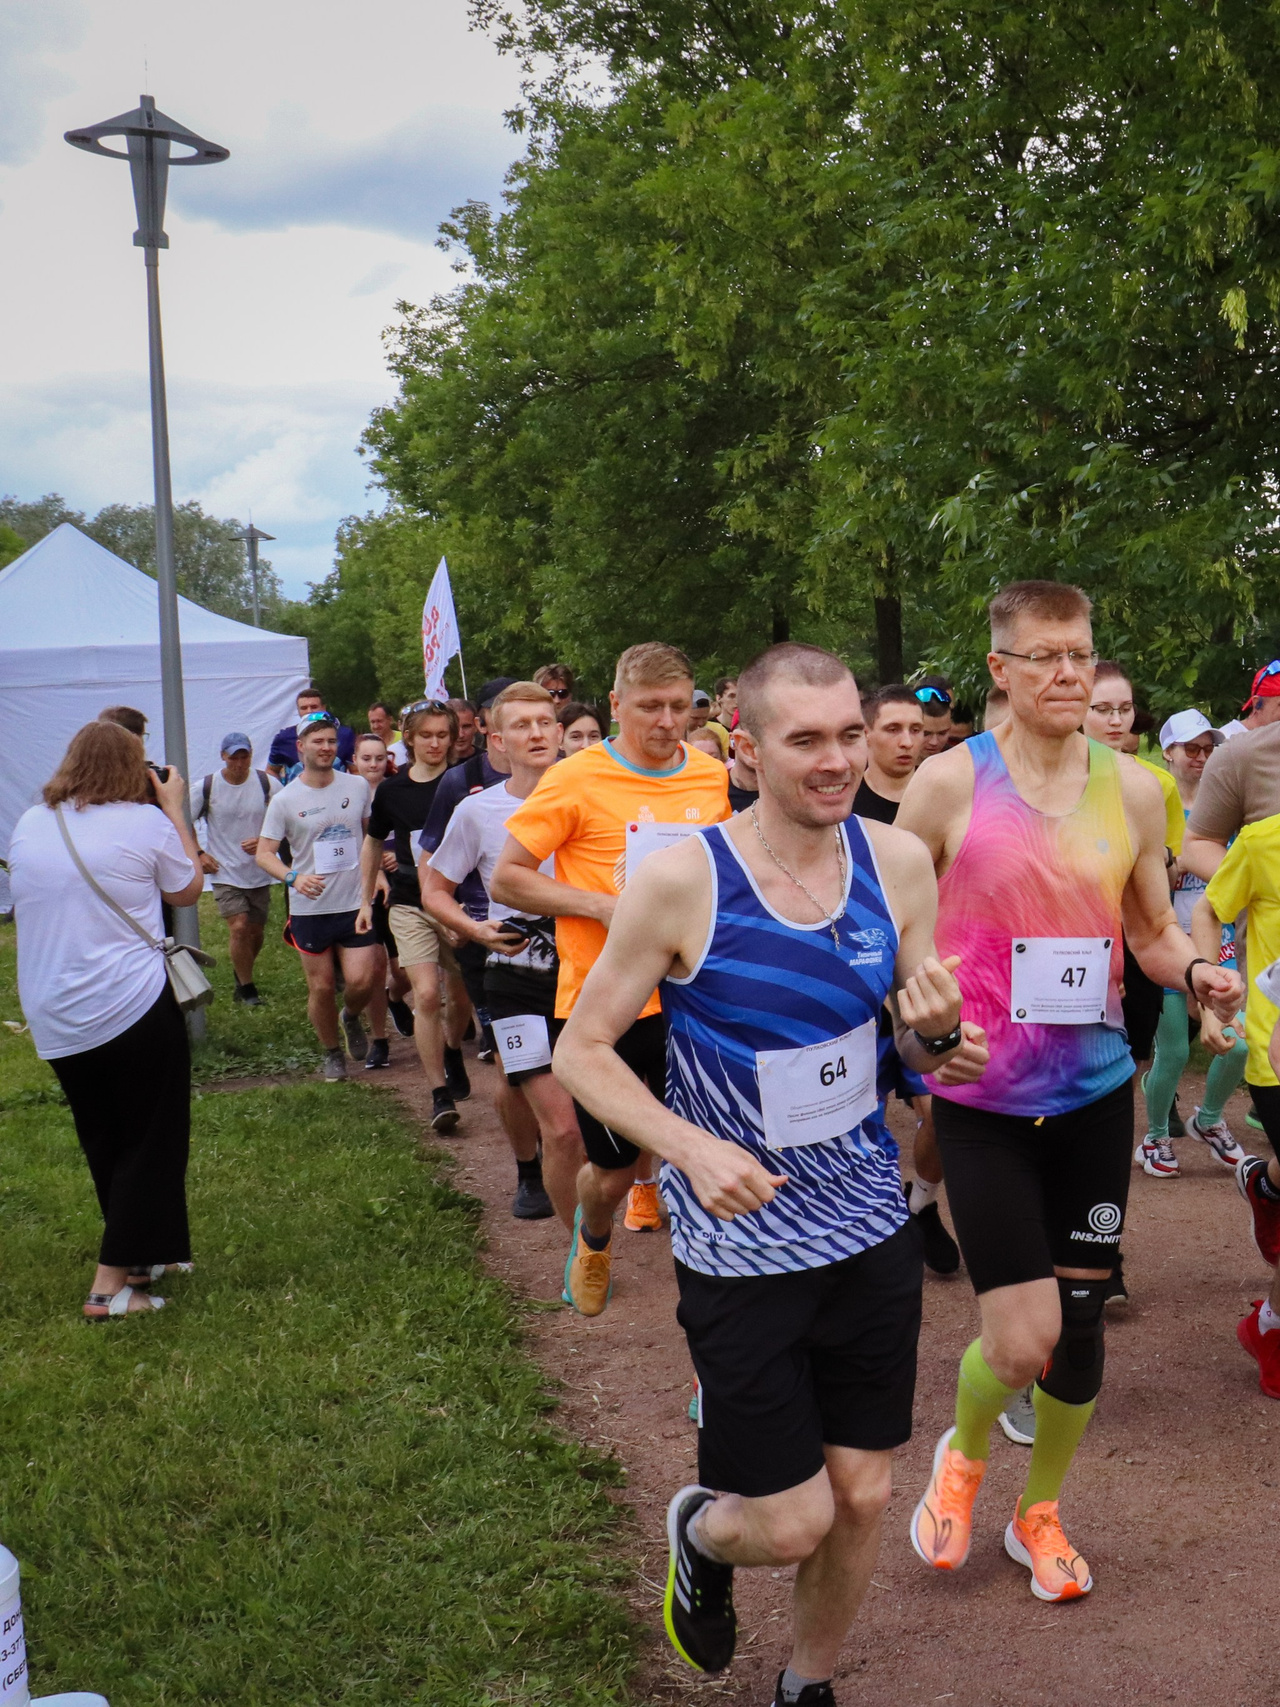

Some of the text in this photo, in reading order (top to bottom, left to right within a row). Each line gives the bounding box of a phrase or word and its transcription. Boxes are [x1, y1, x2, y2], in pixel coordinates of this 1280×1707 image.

[333, 847, 345, 857] 38
[1060, 967, 1087, 988] 47
[506, 1035, 523, 1050] 63
[819, 1055, 847, 1087] 64
